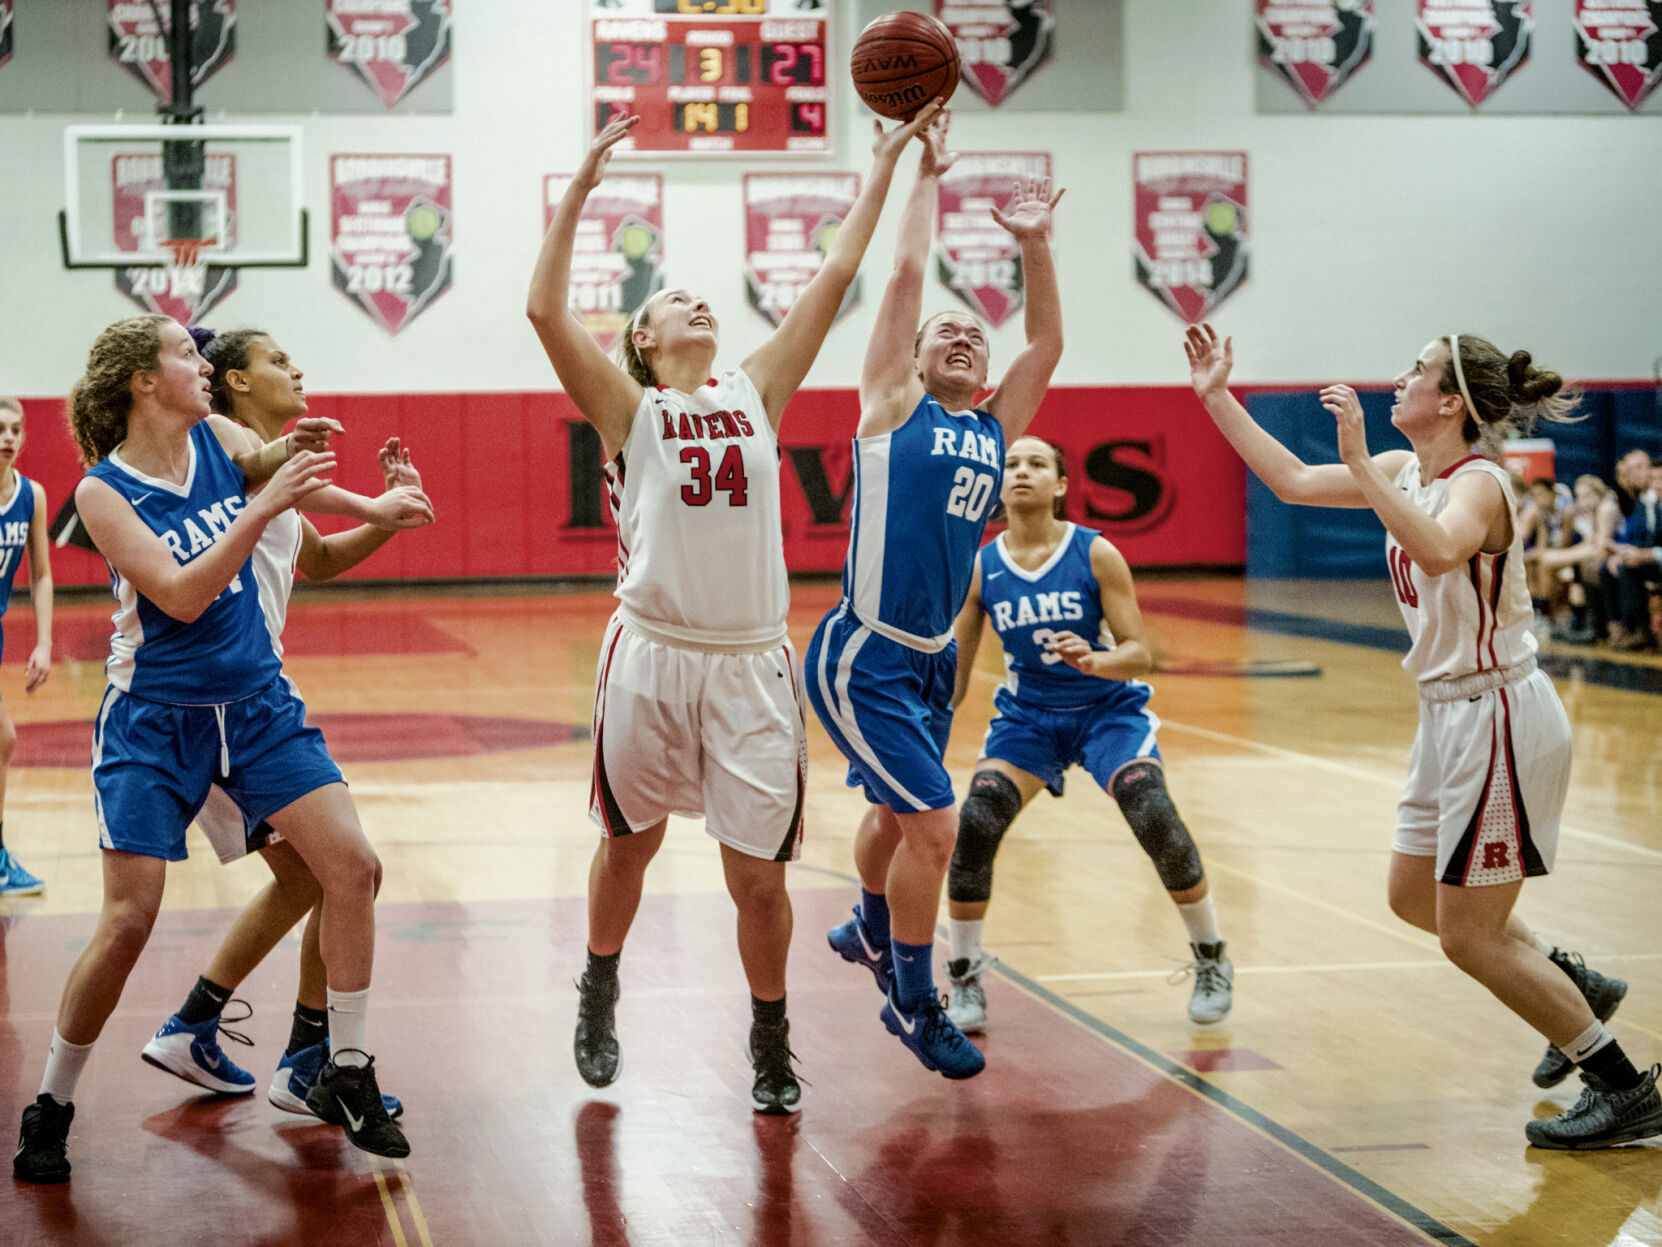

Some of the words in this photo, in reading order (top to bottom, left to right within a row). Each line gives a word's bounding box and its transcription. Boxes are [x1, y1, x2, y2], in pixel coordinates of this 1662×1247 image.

[338, 34, 407, 62] 2010
[607, 44, 663, 85] 24
[699, 47, 723, 82] 3
[770, 44, 824, 85] 27
[734, 102, 749, 132] 1
[798, 102, 825, 130] 4
[347, 265, 414, 294] 2012
[662, 409, 755, 440] RAVENS
[930, 427, 1000, 472] RAM
[679, 444, 748, 507] 34
[946, 465, 994, 523] 20
[1389, 546, 1418, 608] 10
[993, 591, 1083, 632] RAMS
[1032, 627, 1064, 665] 3
[1482, 841, 1510, 869] R
